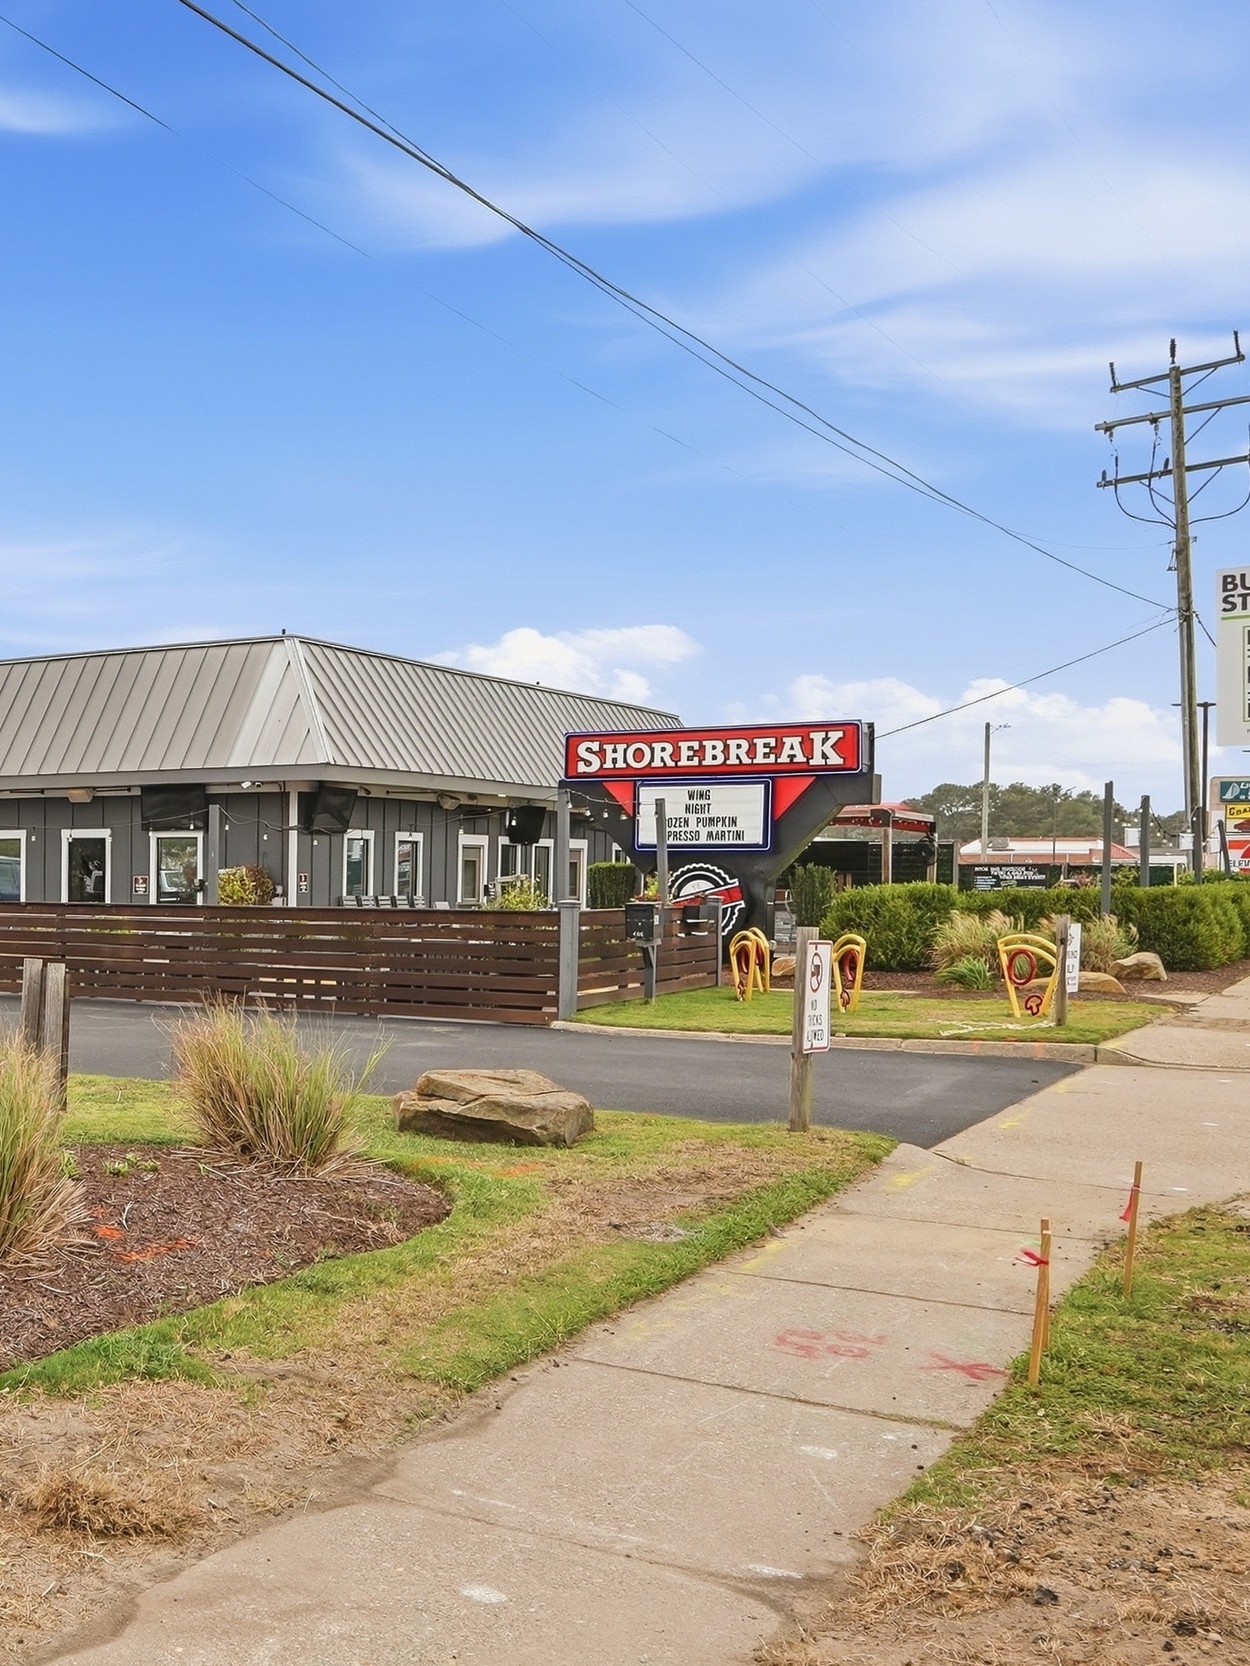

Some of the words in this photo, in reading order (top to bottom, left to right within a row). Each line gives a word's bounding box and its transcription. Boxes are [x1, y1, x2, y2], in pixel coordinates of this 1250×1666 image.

[577, 730, 844, 773] SHOREBREAK
[687, 790, 711, 801] WING
[685, 803, 711, 814] NIGHT
[667, 817, 689, 828] OZEN
[696, 816, 738, 828] PUMPKIN
[667, 830, 700, 841] PRESSO
[706, 830, 745, 841] MARTINI
